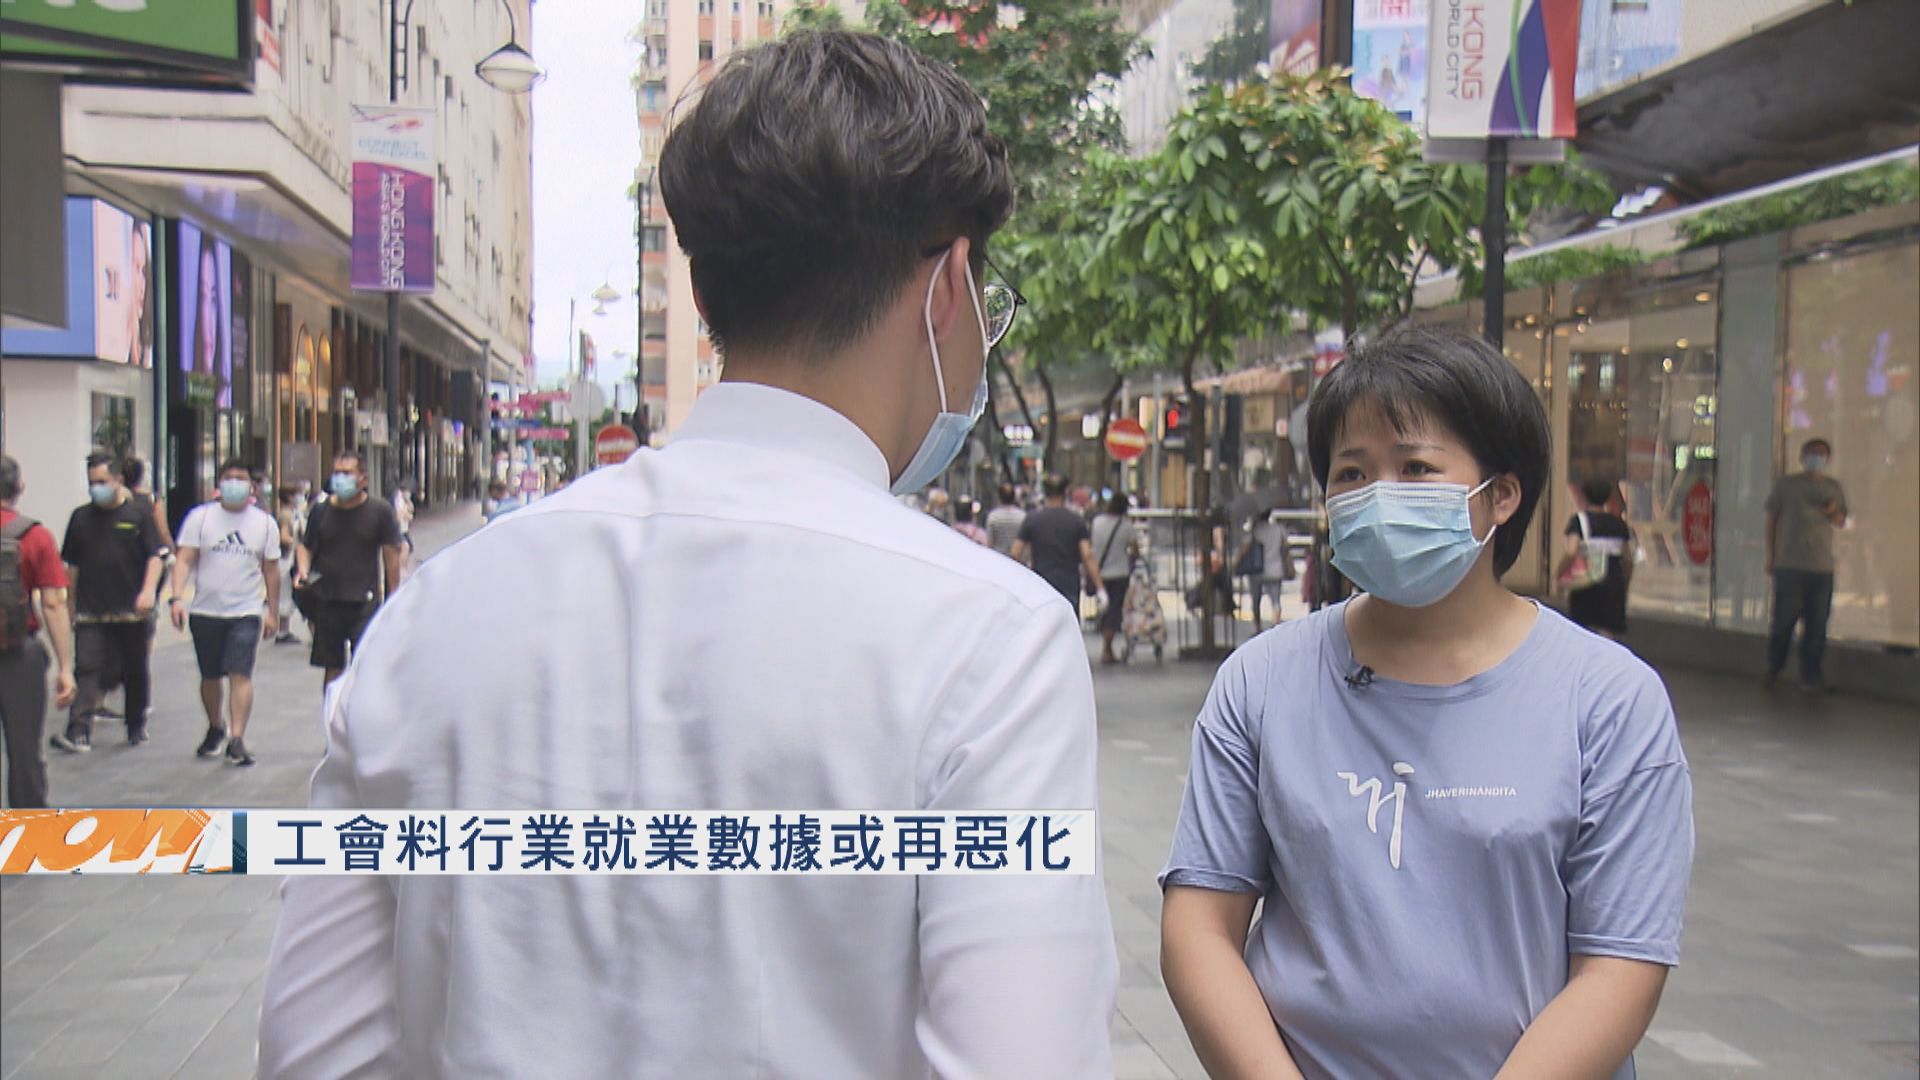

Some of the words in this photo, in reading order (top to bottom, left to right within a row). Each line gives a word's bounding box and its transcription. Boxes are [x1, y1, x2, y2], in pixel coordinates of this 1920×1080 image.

[1446, 52, 1459, 99] CITY
[1462, 7, 1484, 99] KONG
[391, 172, 405, 229] HONG
[391, 232, 405, 288] KONG
[1424, 784, 1517, 799] JHAVERINANDITA
